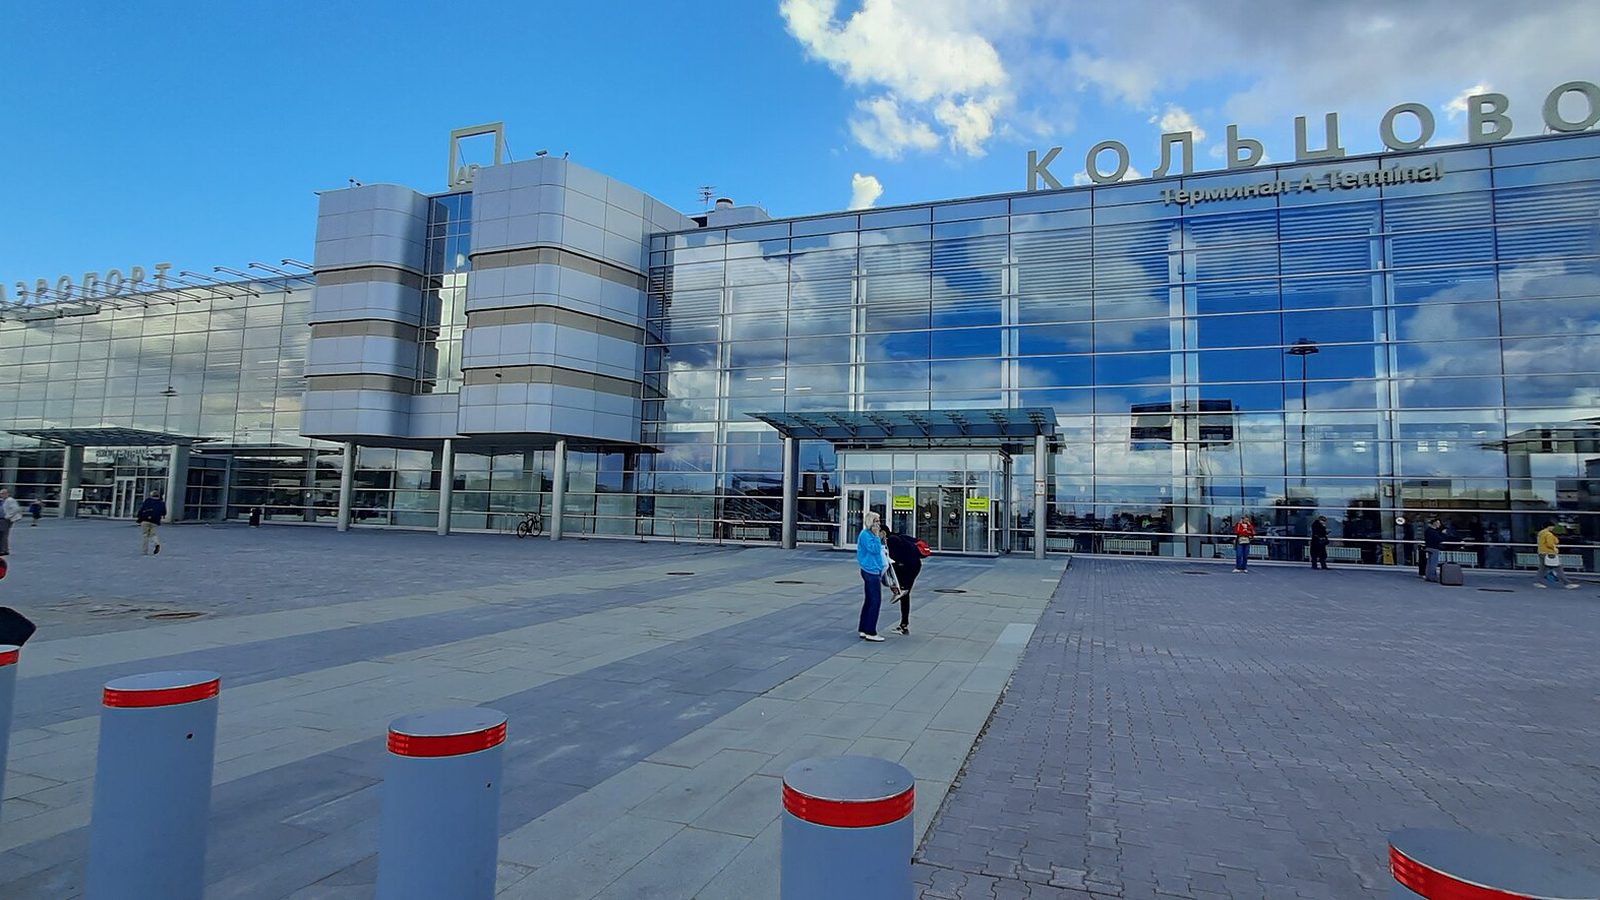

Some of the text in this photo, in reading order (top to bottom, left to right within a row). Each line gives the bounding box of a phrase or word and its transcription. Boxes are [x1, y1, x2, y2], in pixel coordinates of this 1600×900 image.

[1027, 81, 1600, 192] КОЛЬЦОВО
[1162, 174, 1291, 206] Терминал
[1325, 158, 1445, 191] Terminal
